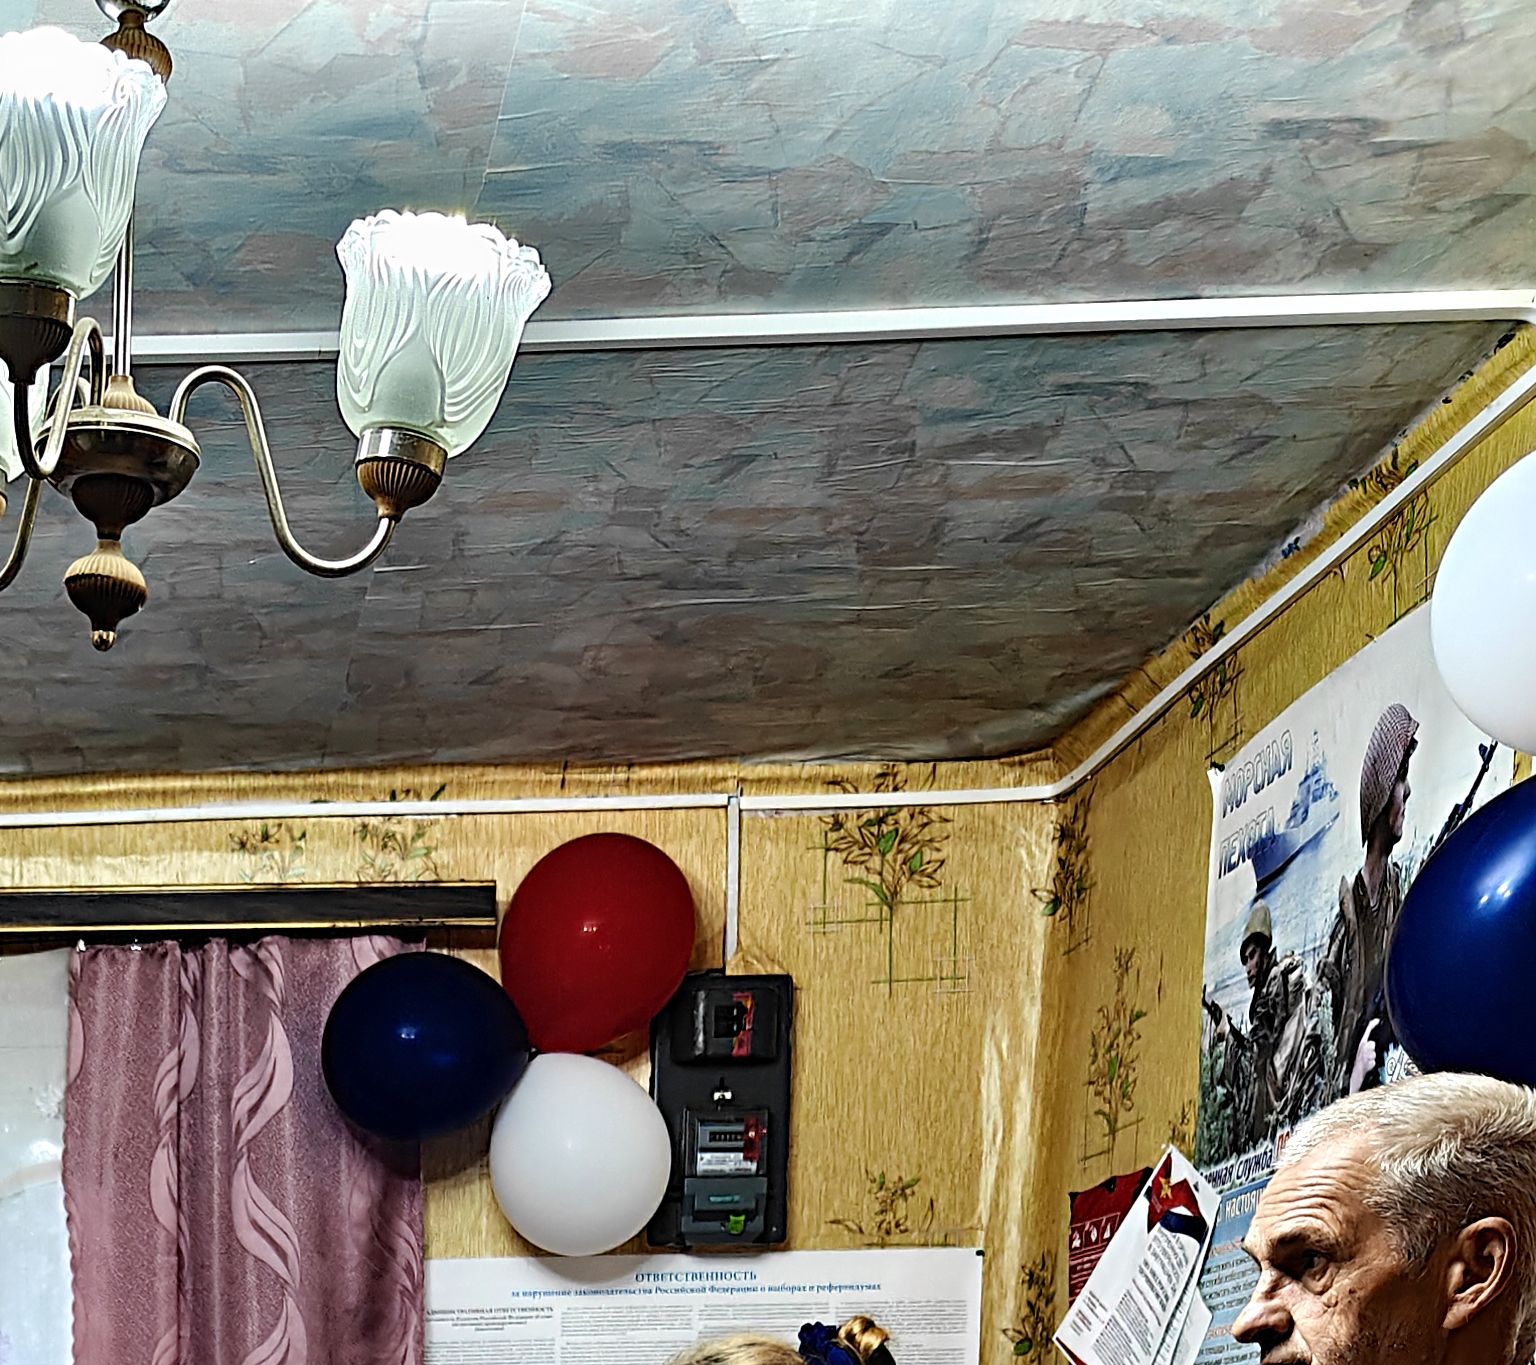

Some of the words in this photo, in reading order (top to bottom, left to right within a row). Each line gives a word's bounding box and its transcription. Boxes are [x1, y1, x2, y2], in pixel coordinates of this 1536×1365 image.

[1222, 729, 1293, 818] МОРСКАЯ
[1200, 1163, 1235, 1189] енная
[1236, 1149, 1273, 1184] служба
[635, 1271, 757, 1284] ОТВЕТСТВЕННОСТЬ
[654, 1285, 706, 1296] Российской
[708, 1284, 759, 1296] Федерации
